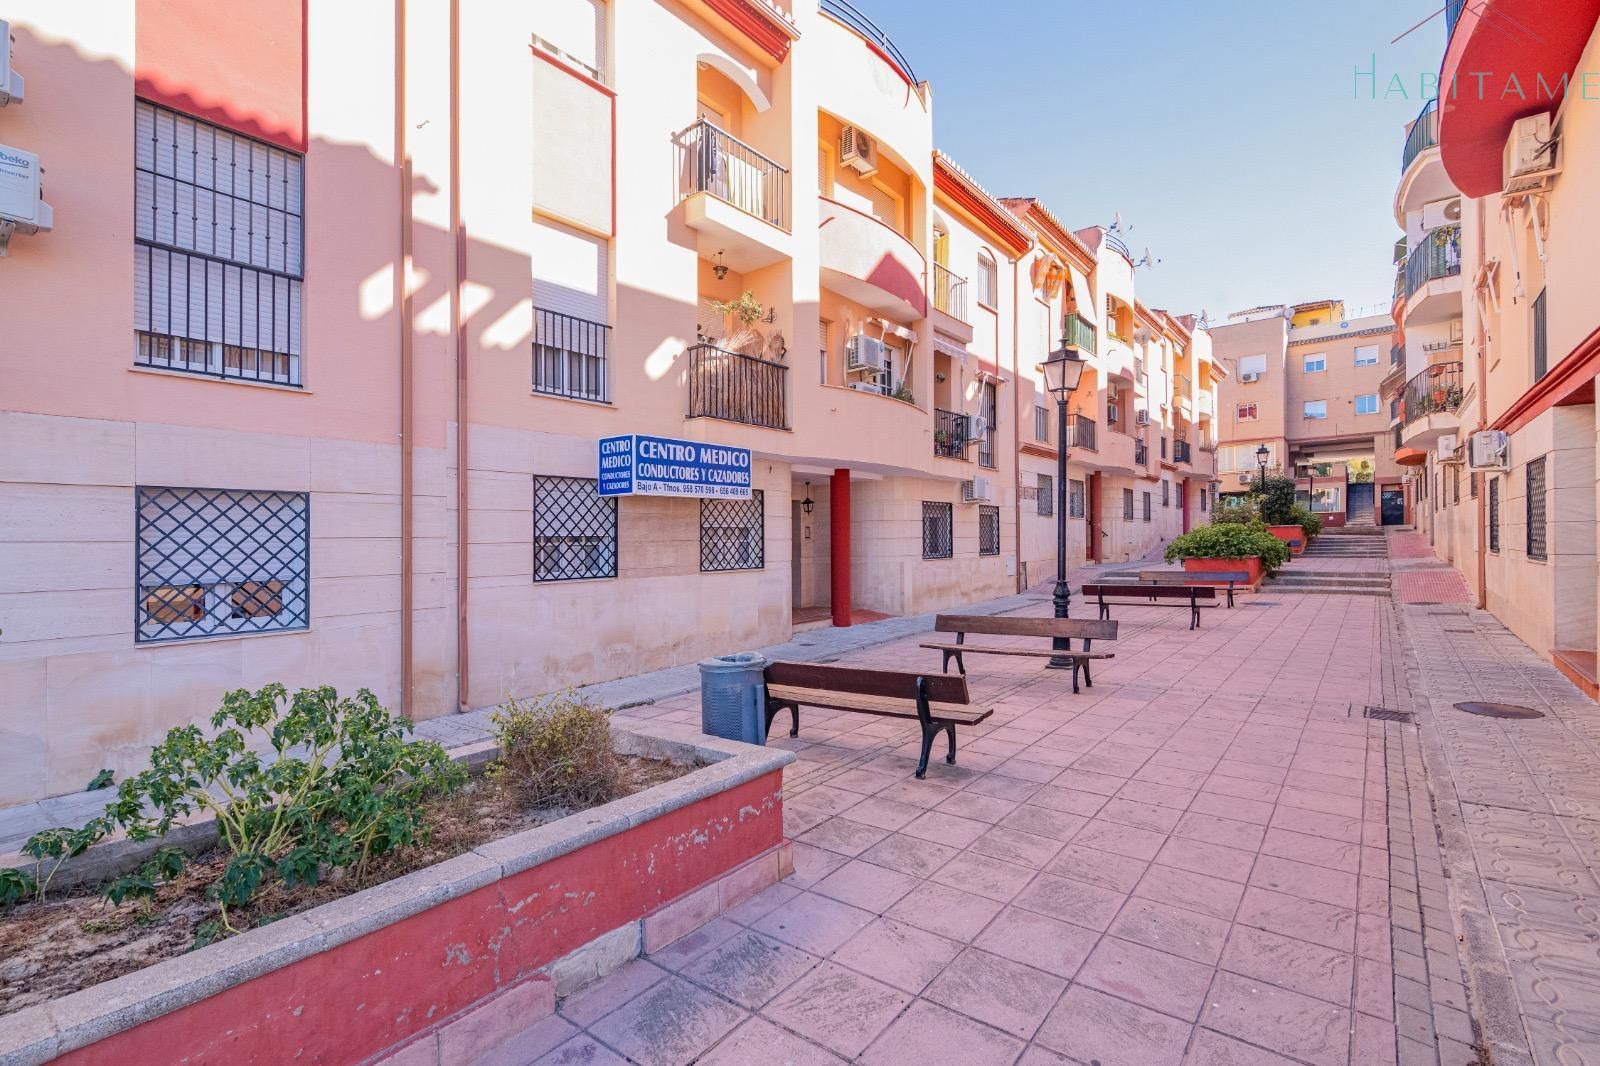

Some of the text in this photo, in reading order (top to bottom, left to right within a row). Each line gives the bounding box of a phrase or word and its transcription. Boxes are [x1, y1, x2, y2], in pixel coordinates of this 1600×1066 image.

[601, 440, 631, 454] CENTRO
[639, 440, 749, 468] CENTRO MEDICO
[601, 454, 632, 469] MEDICO
[601, 470, 631, 481] CONDUCTORES
[638, 462, 750, 485] CONDUCTORES Y CAZADORES
[637, 481, 652, 493] Bajo
[653, 482, 658, 491] A
[663, 483, 682, 493] Tfnos.
[683, 484, 693, 493] 958
